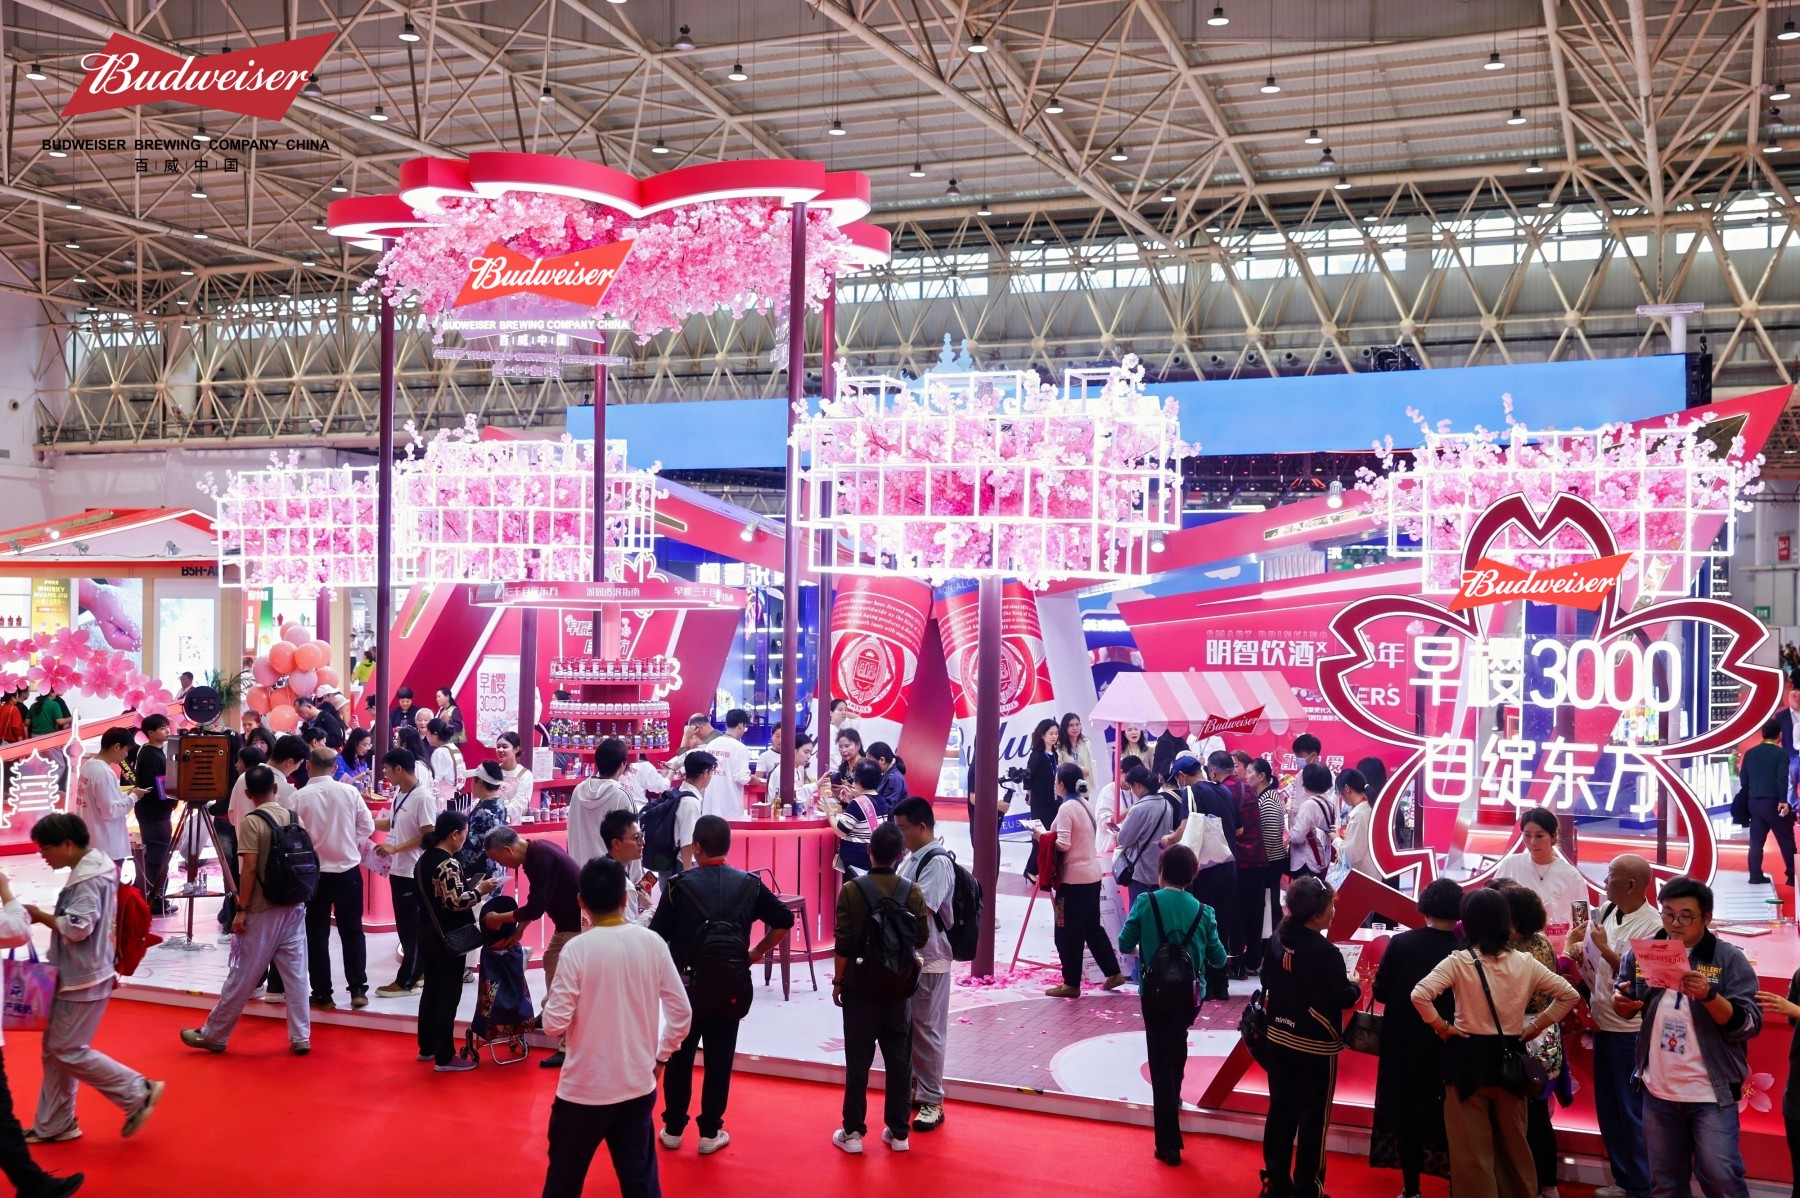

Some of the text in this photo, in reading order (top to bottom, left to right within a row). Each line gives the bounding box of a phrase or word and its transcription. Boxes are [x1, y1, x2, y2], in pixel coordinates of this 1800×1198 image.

[468, 256, 615, 290] Budweiser
[443, 320, 631, 331] BUDWEISER BREWING COMPANY CHINA
[37, 585, 66, 593] WHISKY
[1461, 568, 1617, 598] Budweiser
[1206, 639, 1315, 667] 明智饮酒
[480, 673, 506, 694] 早樱
[1409, 635, 1682, 712] 早樱3000
[1202, 716, 1259, 733] Budweiser
[1424, 731, 1663, 814] 自绽东方
[1696, 964, 1722, 975] GALLERY
